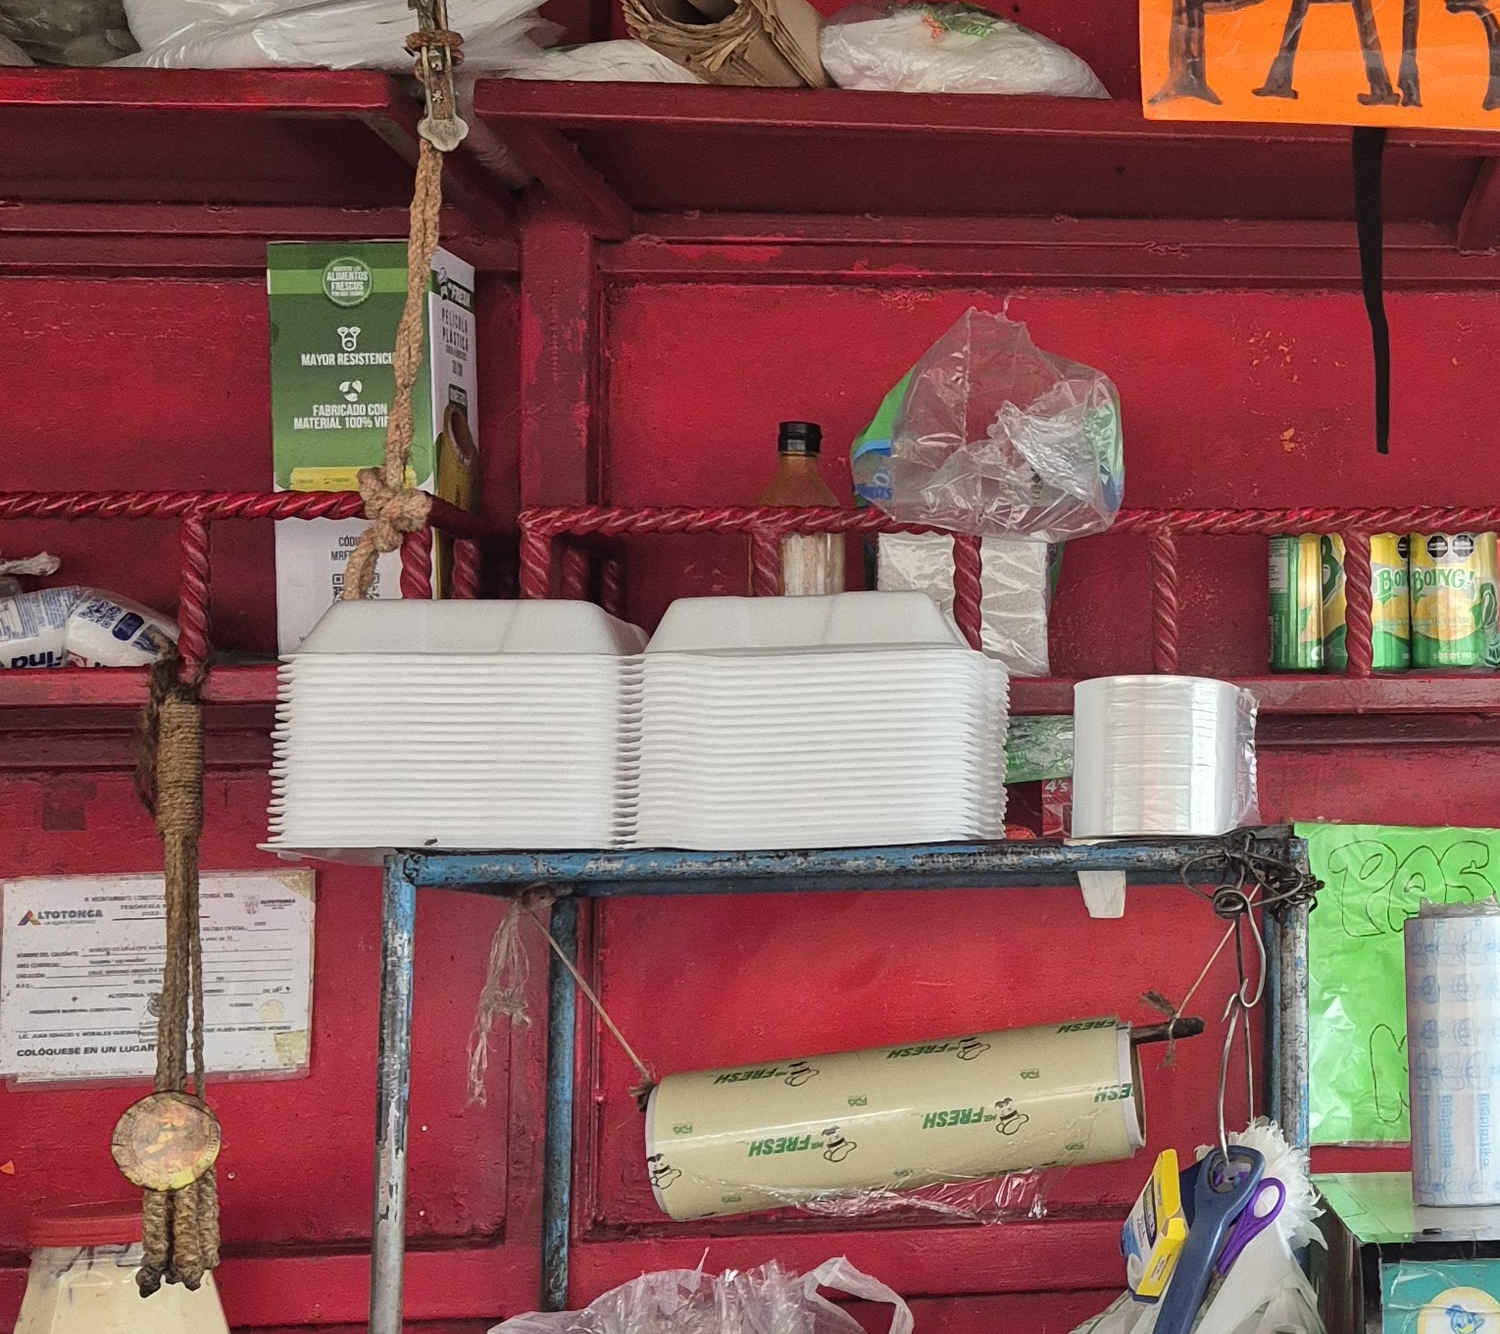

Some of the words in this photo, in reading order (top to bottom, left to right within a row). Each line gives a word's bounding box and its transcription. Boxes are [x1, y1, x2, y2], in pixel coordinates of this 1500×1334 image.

[326, 271, 368, 281] ALIMENTOS
[301, 353, 336, 366] MAYOR
[337, 352, 394, 365] RESISTENCI
[312, 405, 366, 417] FABRICADO
[367, 403, 388, 416] CON
[294, 418, 342, 430] MATERIAL
[344, 417, 373, 429] 100%
[1411, 568, 1476, 601] BOING!
[887, 1043, 949, 1059] FRESH
[714, 1068, 780, 1085] FRESH
[1094, 1083, 1134, 1103] ESH
[922, 1106, 985, 1130] FRESH
[748, 1134, 811, 1157] FRESH
